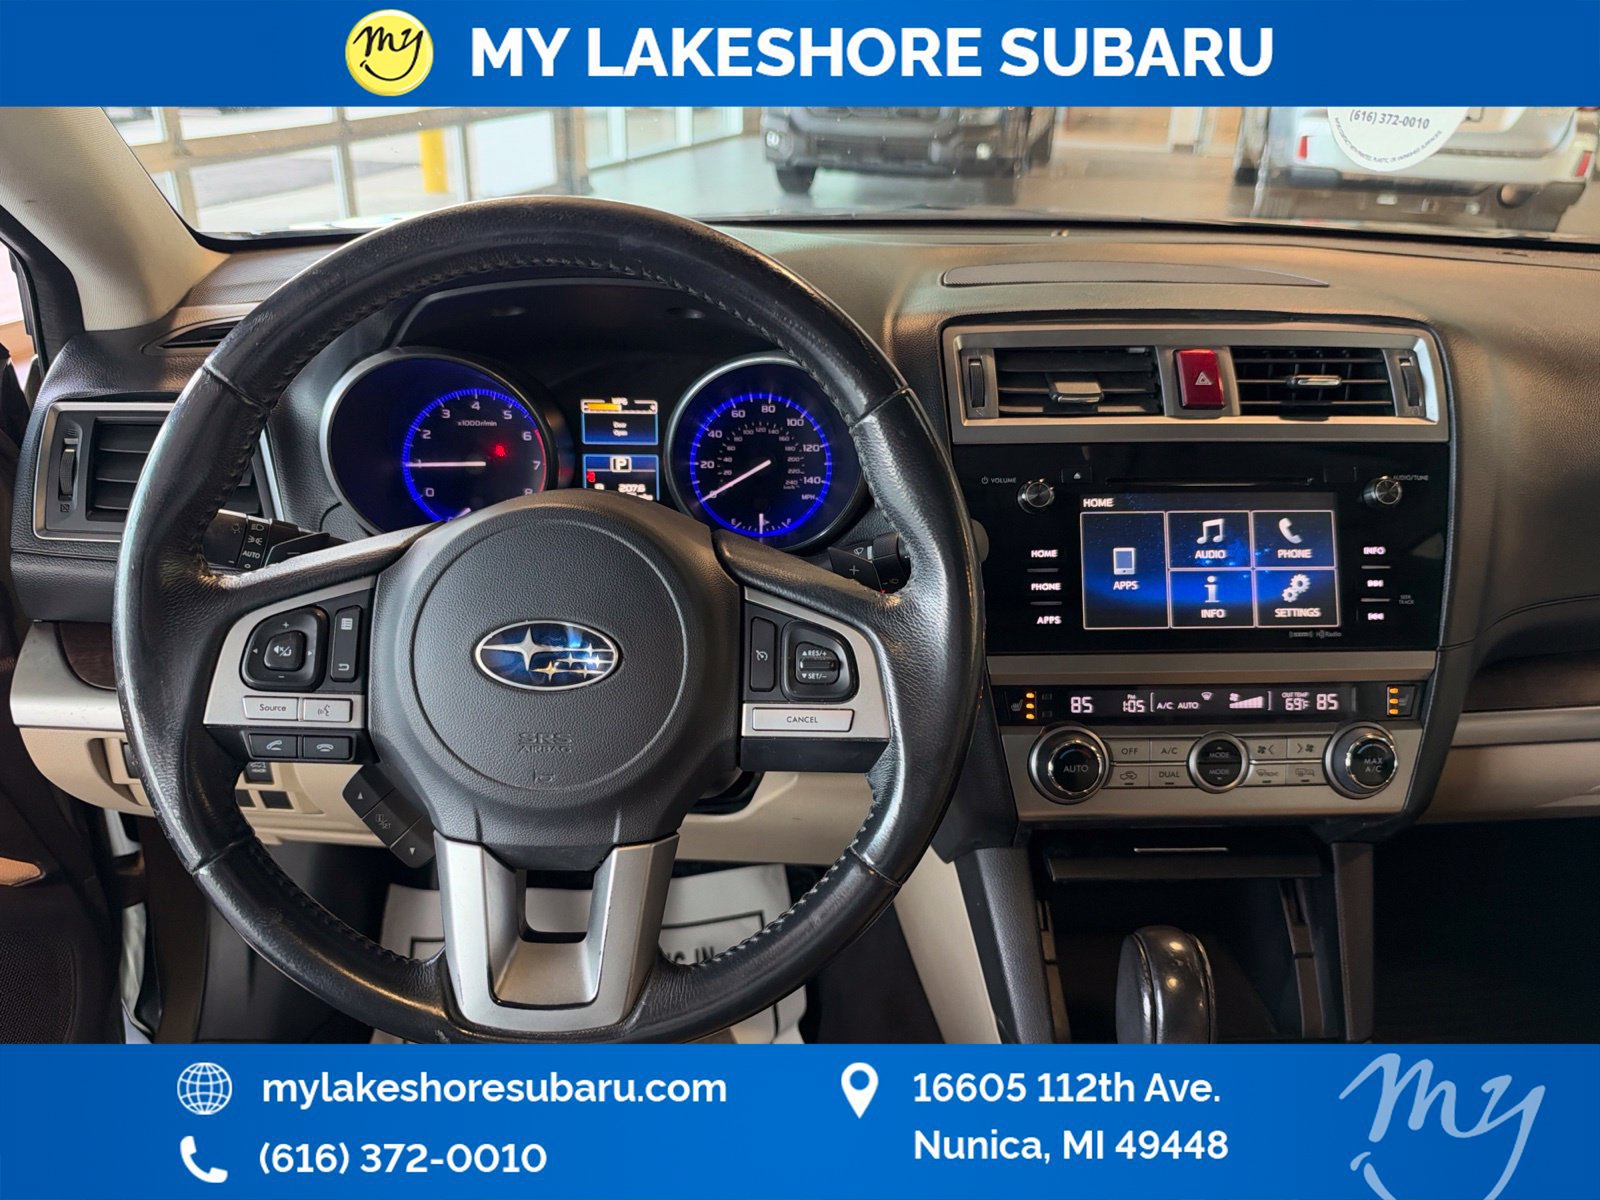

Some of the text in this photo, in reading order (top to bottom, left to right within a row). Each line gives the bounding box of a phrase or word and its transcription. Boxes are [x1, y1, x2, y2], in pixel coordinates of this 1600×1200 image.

[1349, 109, 1431, 130] (616) 372-0010
[471, 401, 481, 411] 4
[761, 405, 776, 414] 80
[441, 409, 451, 419] 3
[503, 410, 512, 420] 5
[731, 409, 746, 418] 60
[786, 418, 805, 427] 100
[422, 430, 431, 439] 2
[523, 432, 532, 441] 6
[708, 430, 723, 438] 40
[802, 444, 820, 452] 120
[532, 461, 541, 470] 7
[700, 460, 715, 469] 20
[803, 476, 822, 485] 140
[425, 487, 435, 498] 0
[1083, 498, 1114, 508] HOME
[242, 550, 261, 560] AUTO
[1031, 549, 1058, 558] HOME
[1194, 550, 1227, 559] AUDIO
[1277, 549, 1312, 559] PHONE
[1363, 547, 1386, 555] INFO
[1031, 582, 1062, 591] PHONE
[1113, 581, 1140, 591] APPS
[1201, 609, 1226, 619] INFO
[1274, 608, 1322, 618] SETTINGS
[1036, 615, 1062, 625] APPS
[1070, 696, 1094, 714] 85
[1123, 700, 1146, 713] 1:05
[1156, 701, 1199, 710] A/C AUTO
[1316, 693, 1339, 711] 85
[259, 703, 287, 712] Source
[786, 715, 818, 724] CANCEL
[518, 732, 573, 744] SRS
[1121, 747, 1139, 755] OFF
[1160, 747, 1178, 755] A/C
[1209, 751, 1230, 759] MODE
[1364, 757, 1383, 765] MAX
[1063, 764, 1089, 773] AUTO
[1208, 768, 1229, 776] MODE
[1364, 764, 1383, 773] A/C
[1158, 771, 1180, 779] DUAL
